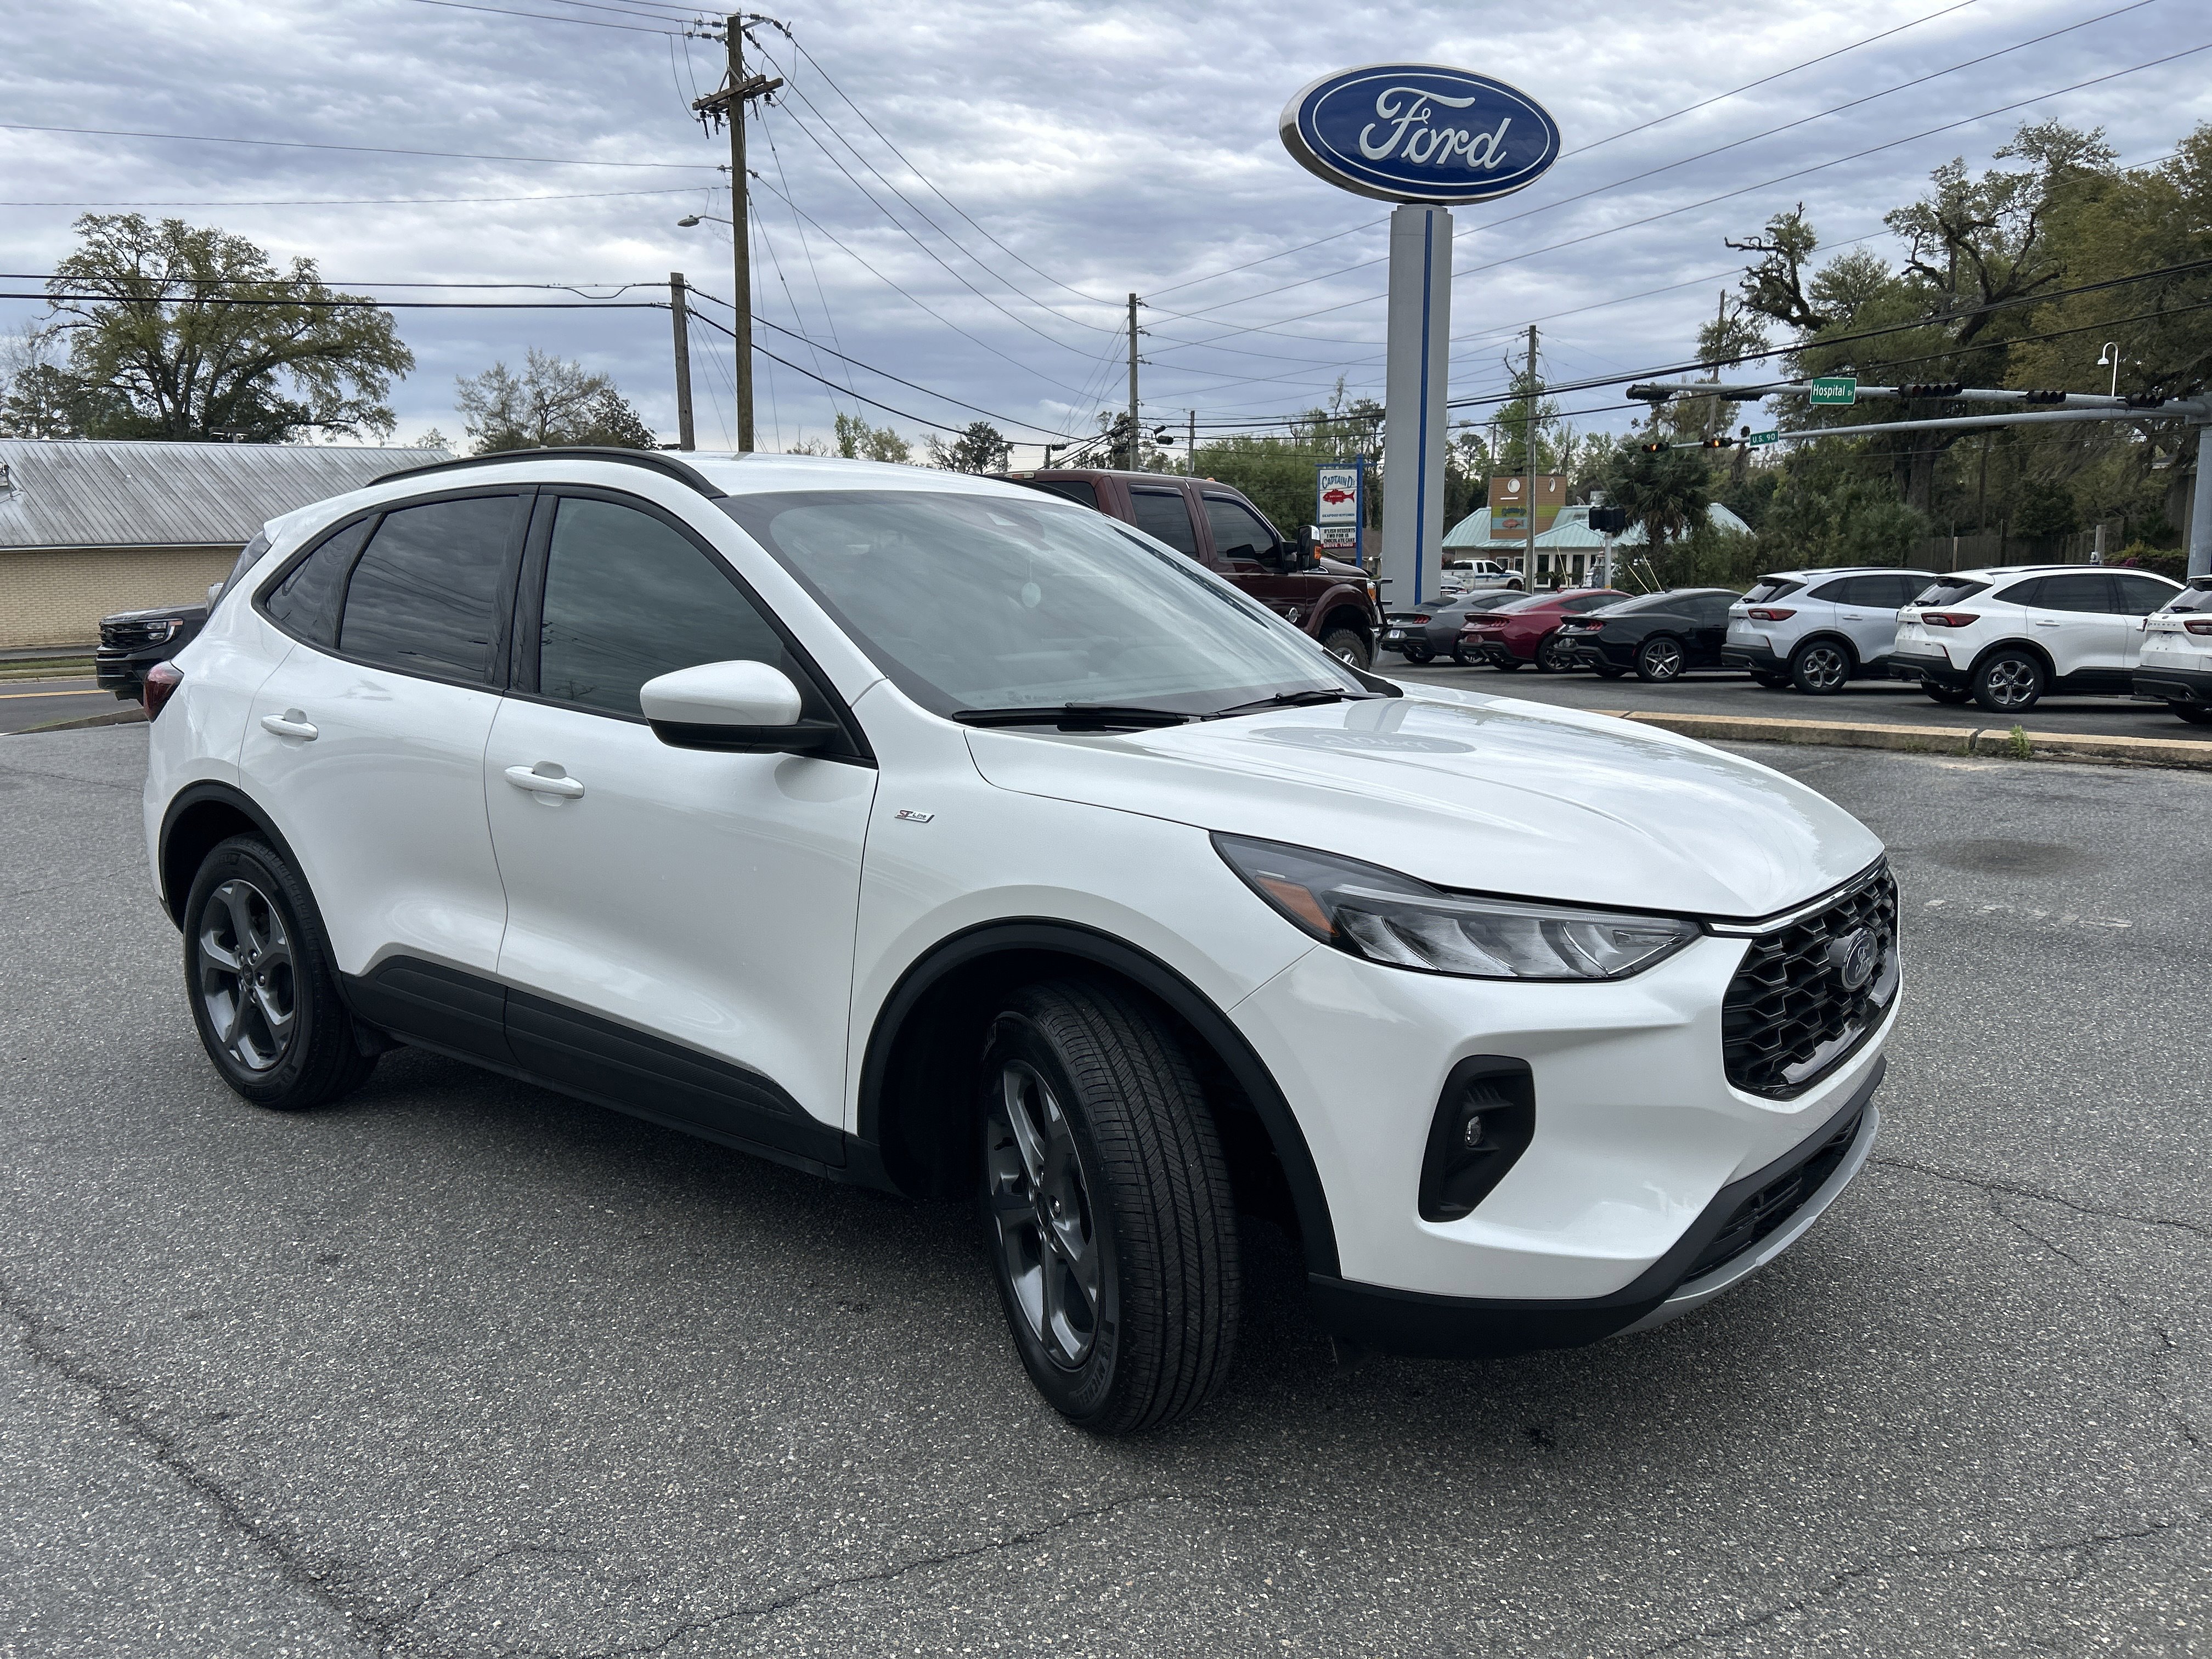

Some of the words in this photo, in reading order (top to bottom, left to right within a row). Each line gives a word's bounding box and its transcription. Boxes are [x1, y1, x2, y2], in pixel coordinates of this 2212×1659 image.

[1359, 87, 1511, 170] Ford
[1813, 384, 1846, 398] Hospital
[1752, 435, 1764, 443] U.S.
[1322, 476, 1347, 489] CAPTAIN
[896, 809, 913, 818] ST
